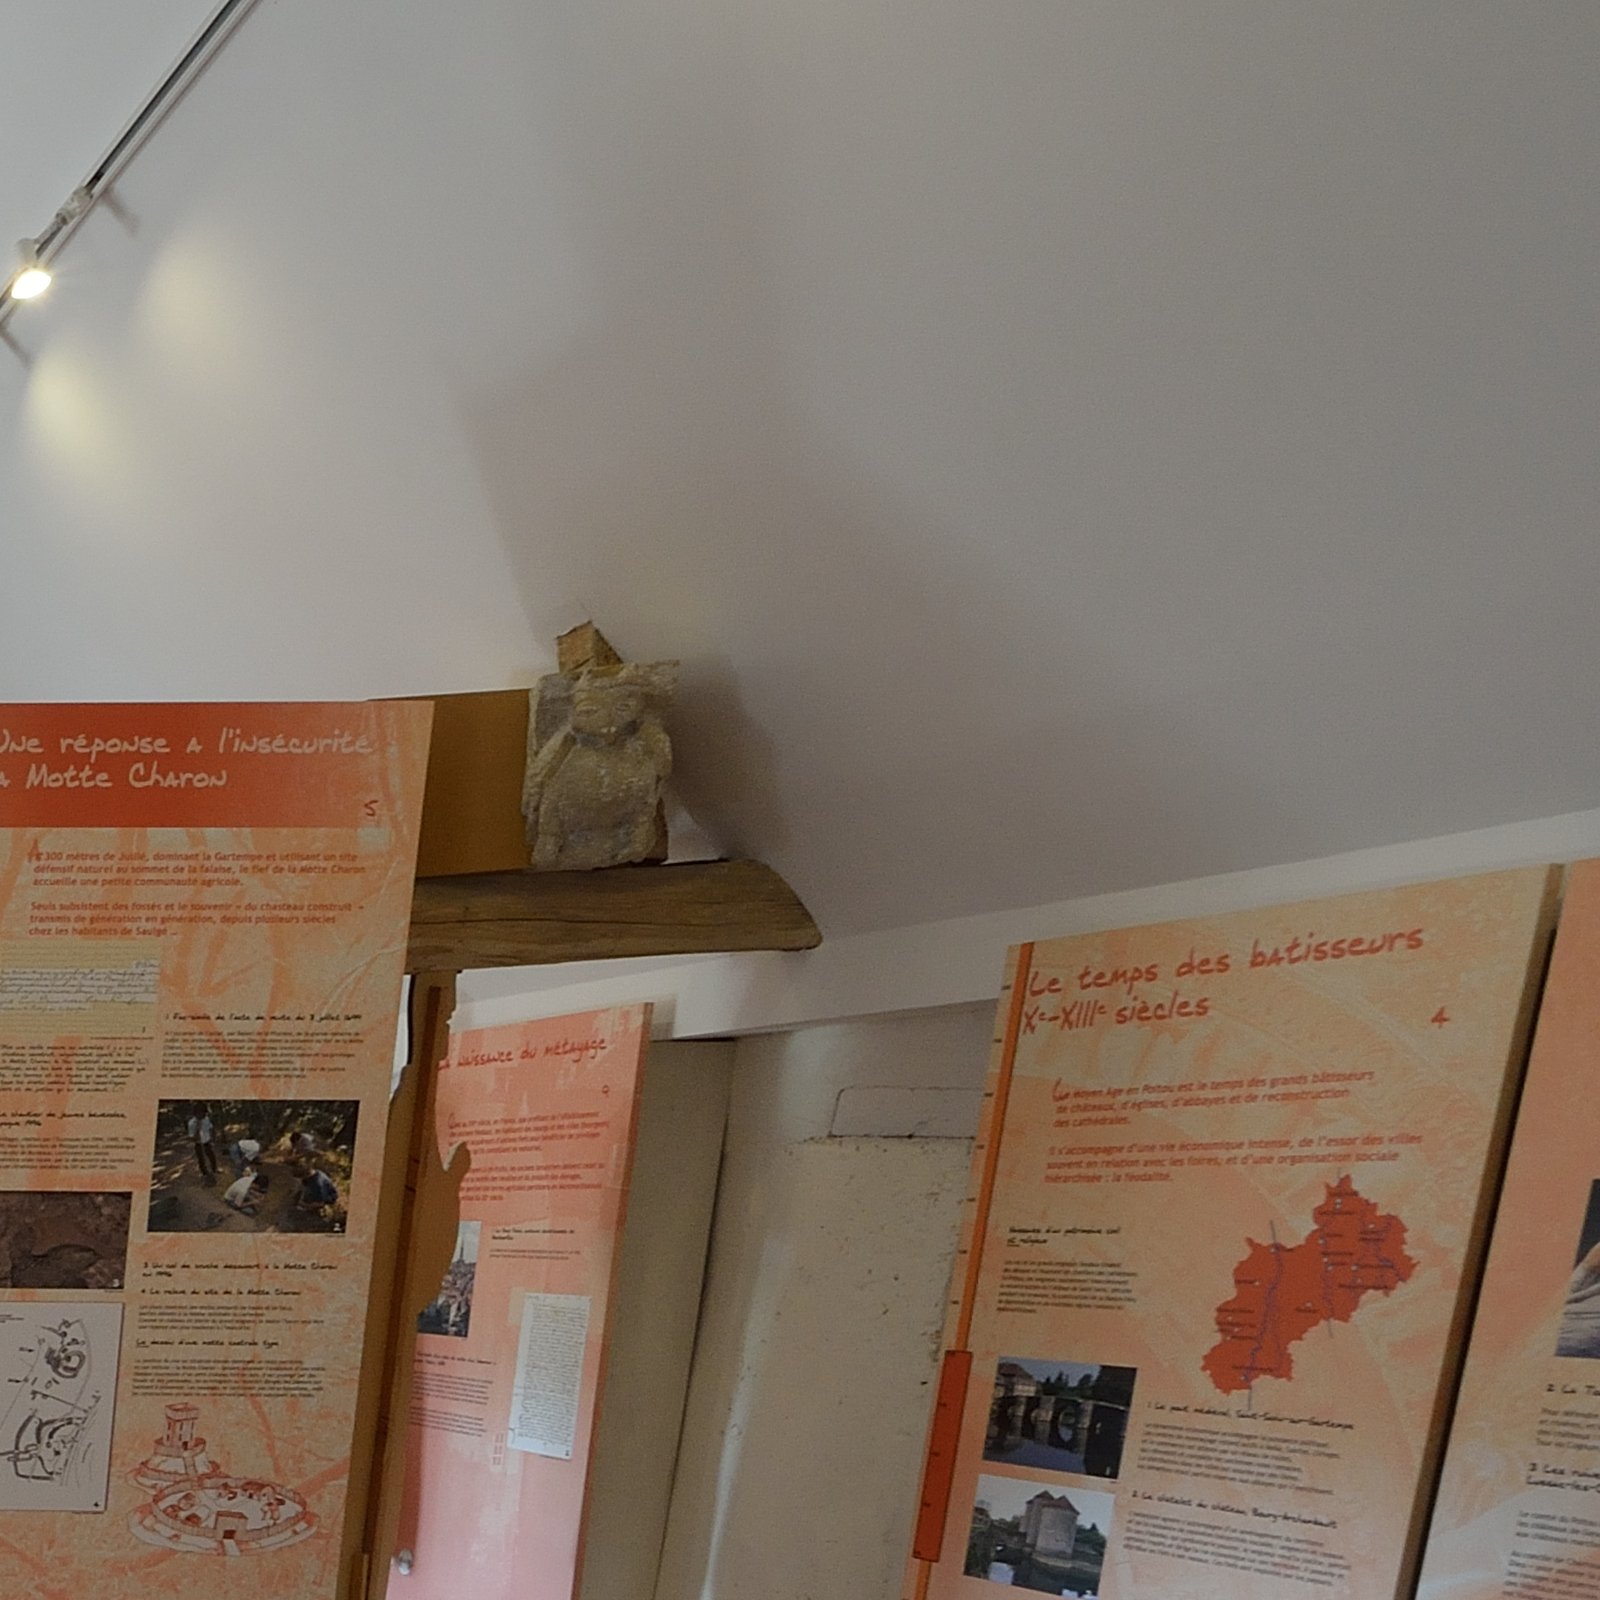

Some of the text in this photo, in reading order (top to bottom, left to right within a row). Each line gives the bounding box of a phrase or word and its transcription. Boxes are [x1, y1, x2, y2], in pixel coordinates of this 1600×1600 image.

[59, 734, 171, 763] réponse
[218, 726, 375, 754] l'insécurité
[25, 762, 115, 789] Motte
[127, 760, 228, 789] Charon
[102, 851, 116, 862] de
[152, 851, 200, 862] dominant
[130, 865, 169, 874] sommet
[171, 864, 185, 874] de
[271, 864, 286, 874] de
[111, 902, 129, 912] des
[163, 903, 176, 912] et
[243, 902, 257, 912] du
[73, 914, 87, 924] de
[1026, 969, 1061, 999] Le
[1076, 962, 1157, 995] temps
[1173, 945, 1230, 981] des
[1113, 988, 1210, 1027] siècles
[1428, 1004, 1450, 1030] 4
[518, 1040, 538, 1060] du
